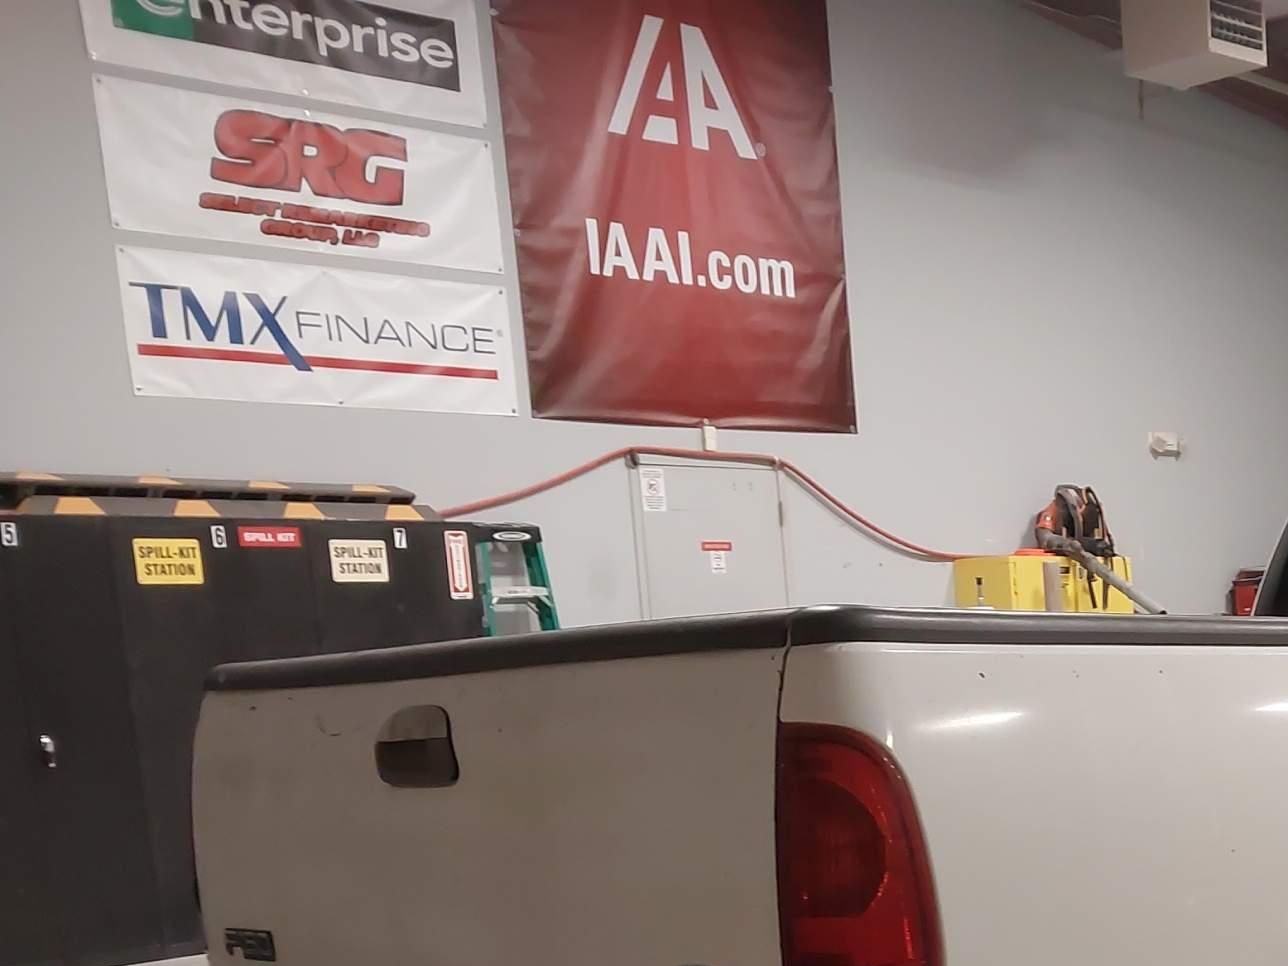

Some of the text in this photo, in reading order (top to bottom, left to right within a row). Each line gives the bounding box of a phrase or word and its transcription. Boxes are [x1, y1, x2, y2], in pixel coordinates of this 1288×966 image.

[210, 109, 408, 206] SRG
[585, 217, 796, 298] IAAI.com
[128, 281, 496, 372] TMX FINANCE
[1, 524, 14, 544] 5
[214, 527, 225, 545] 6
[243, 532, 296, 542] SPILL KIT
[138, 546, 197, 559] SPILL-KIT
[334, 546, 384, 559] SPILL-KIT
[145, 563, 195, 576] STATION
[339, 562, 382, 574] STATION
